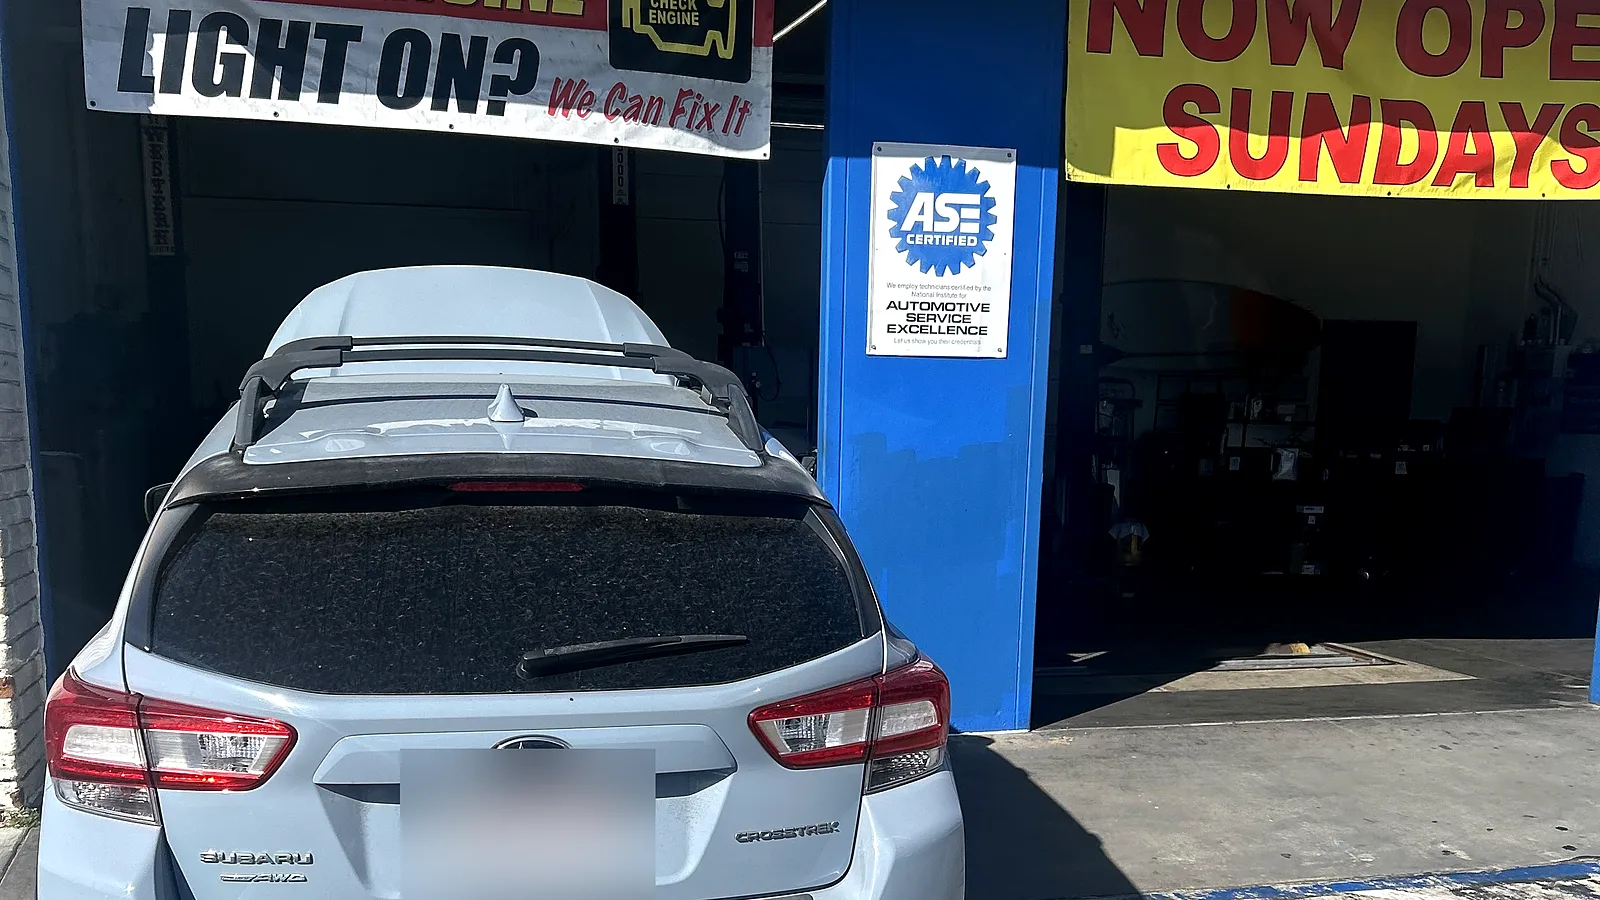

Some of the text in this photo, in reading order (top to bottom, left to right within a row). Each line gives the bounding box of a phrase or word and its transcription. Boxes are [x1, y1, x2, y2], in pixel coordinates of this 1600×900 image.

[650, 0, 698, 11] CHECK
[649, 9, 700, 26] ENGINE
[1086, 0, 1600, 81] NOW OPE
[117, 7, 541, 117] LIGHT ON?
[547, 76, 752, 137] We Can Fix It
[1156, 83, 1600, 190] SUNDAYS
[617, 146, 625, 188] 000
[900, 191, 981, 234] ASE
[906, 234, 978, 247] CERTIFIED
[897, 283, 918, 291] employ
[919, 283, 950, 291] technicians
[886, 300, 990, 313] AUTOMOTIVE
[906, 313, 972, 324] SERVICE
[887, 324, 988, 336] EXCELLENCE
[735, 821, 840, 844] CROSSTREK
[200, 850, 315, 866] SUBARU
